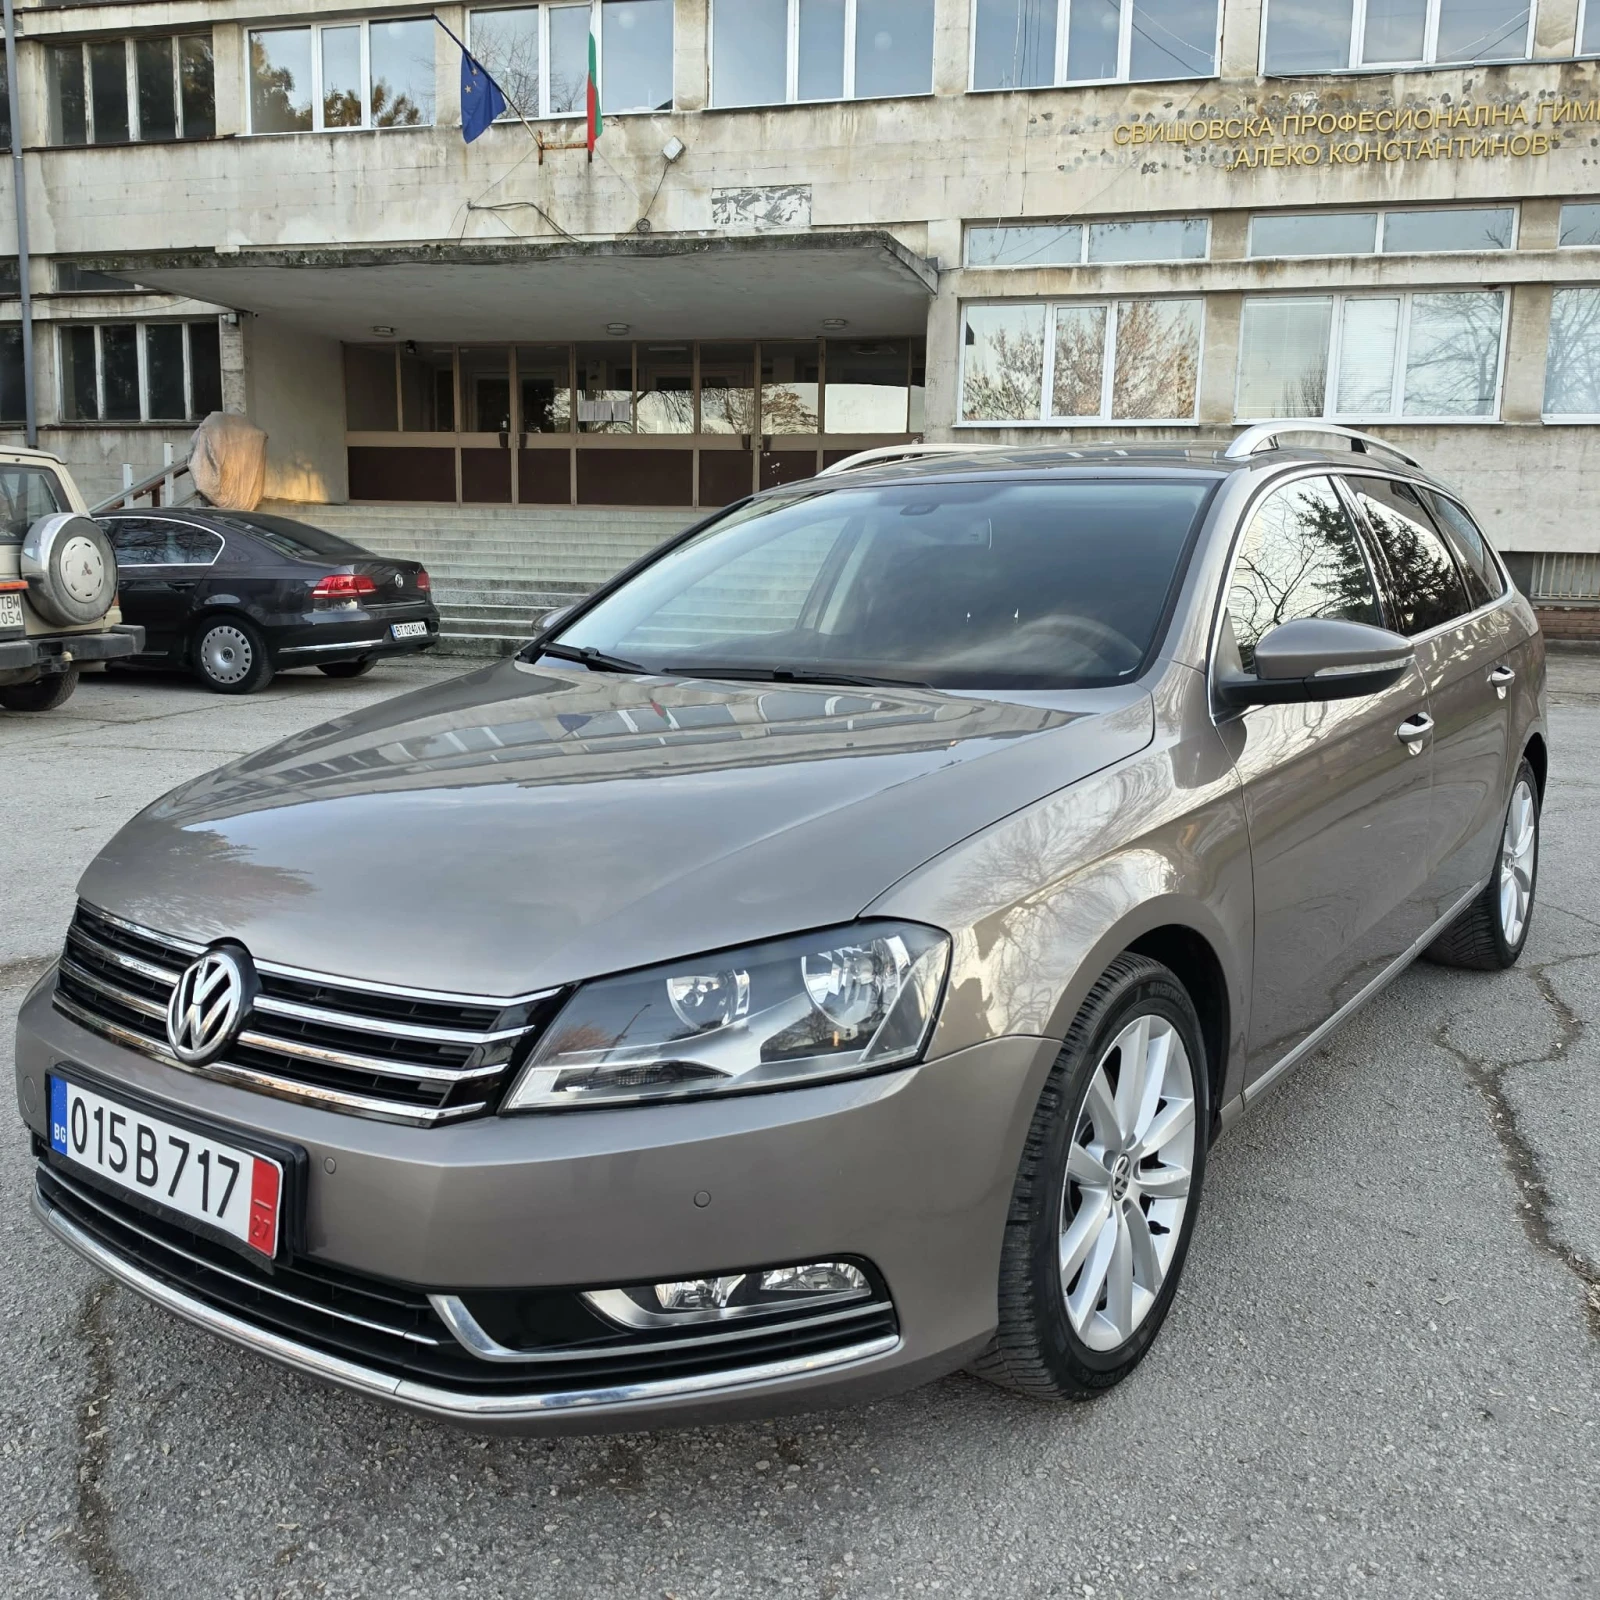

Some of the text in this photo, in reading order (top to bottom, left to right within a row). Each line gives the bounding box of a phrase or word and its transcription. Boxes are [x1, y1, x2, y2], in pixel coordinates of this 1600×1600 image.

[1114, 117, 1274, 145] СВИЩОВСКА
[1283, 103, 1529, 136] ПРОФЕСИОНАЛНА
[167, 953, 241, 1061] VW
[54, 1123, 66, 1143] BG
